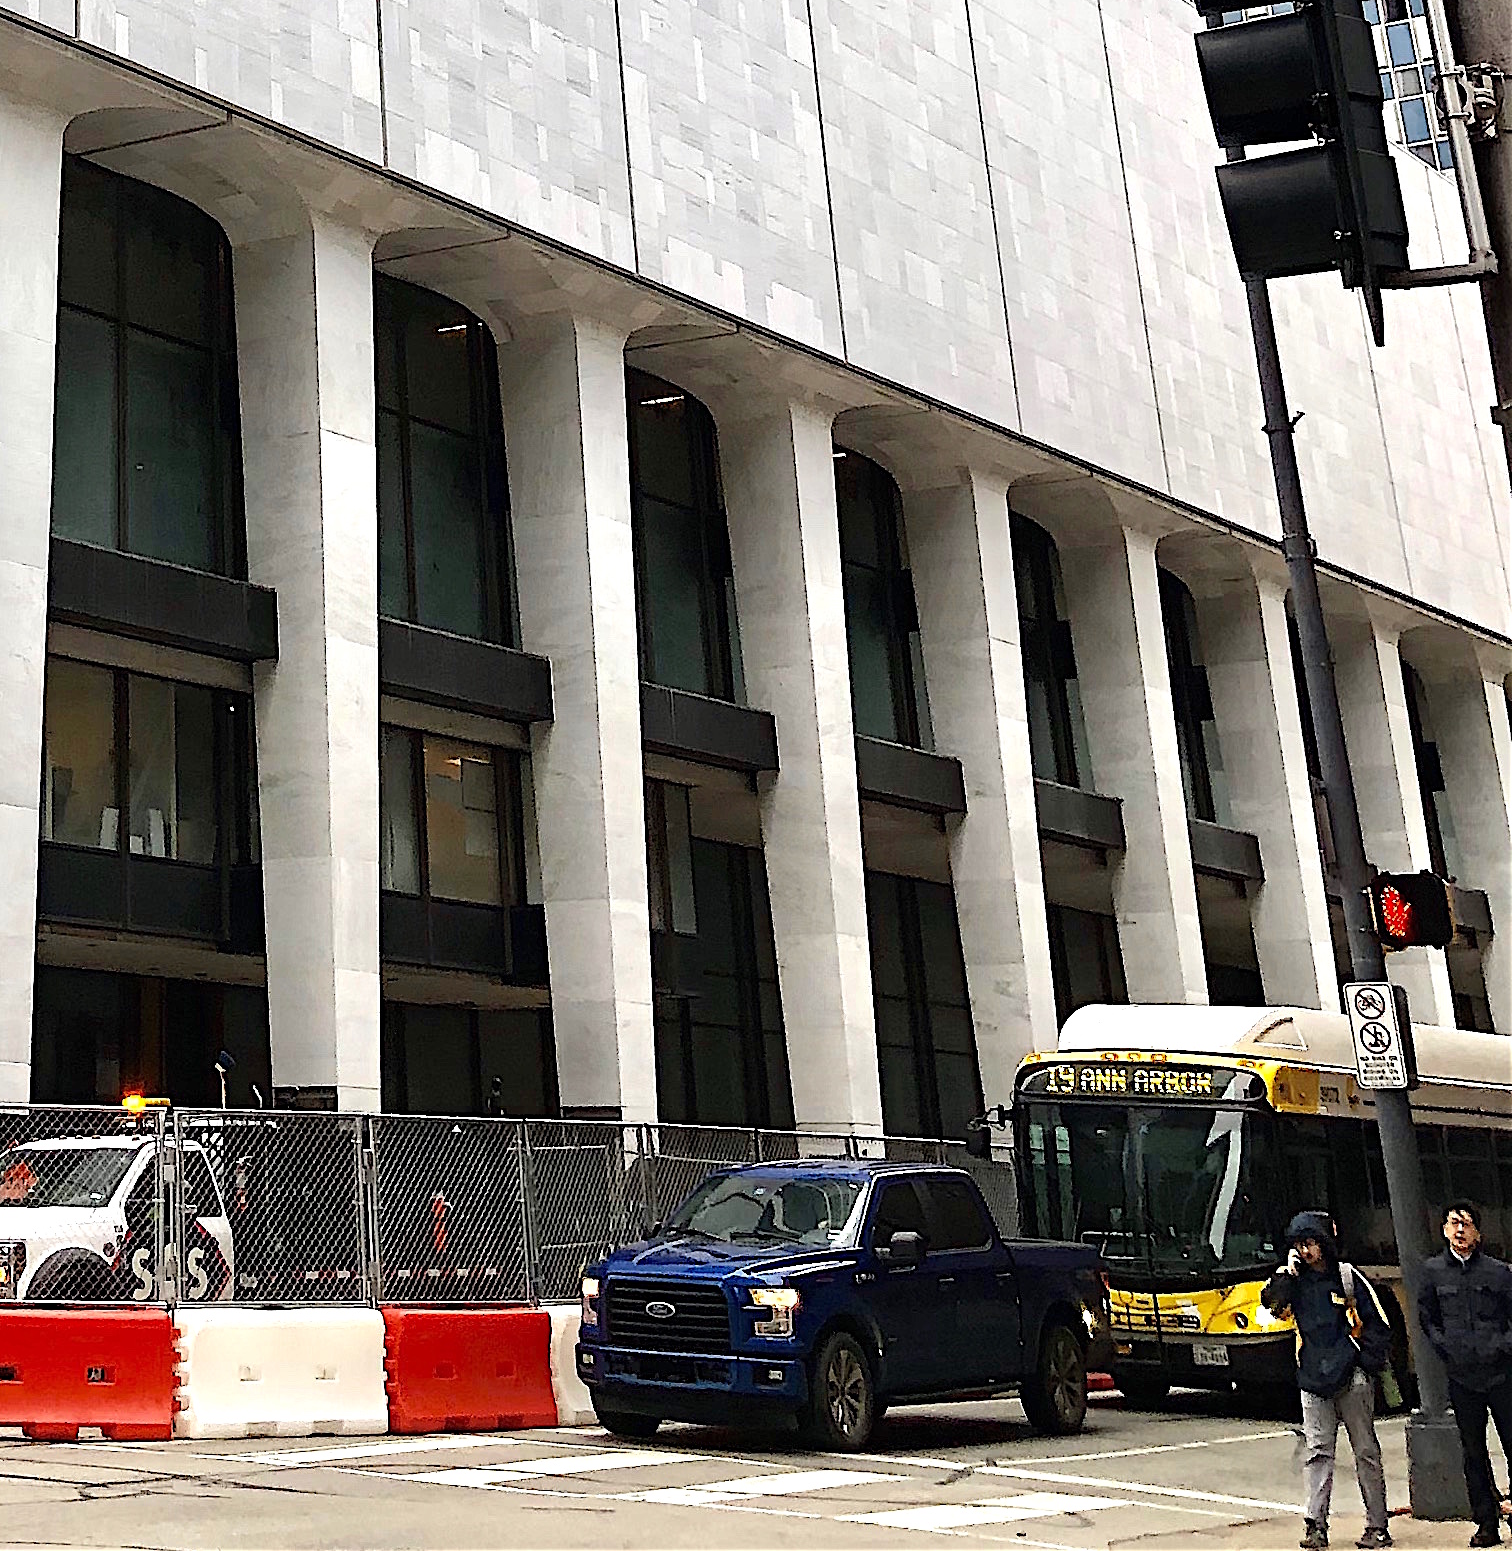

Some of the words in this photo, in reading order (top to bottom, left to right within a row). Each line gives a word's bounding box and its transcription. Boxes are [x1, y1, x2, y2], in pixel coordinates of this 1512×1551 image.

[1045, 1064, 1076, 1094] 19
[1080, 1067, 1128, 1093] ANN
[1133, 1069, 1212, 1094] ARBOR
